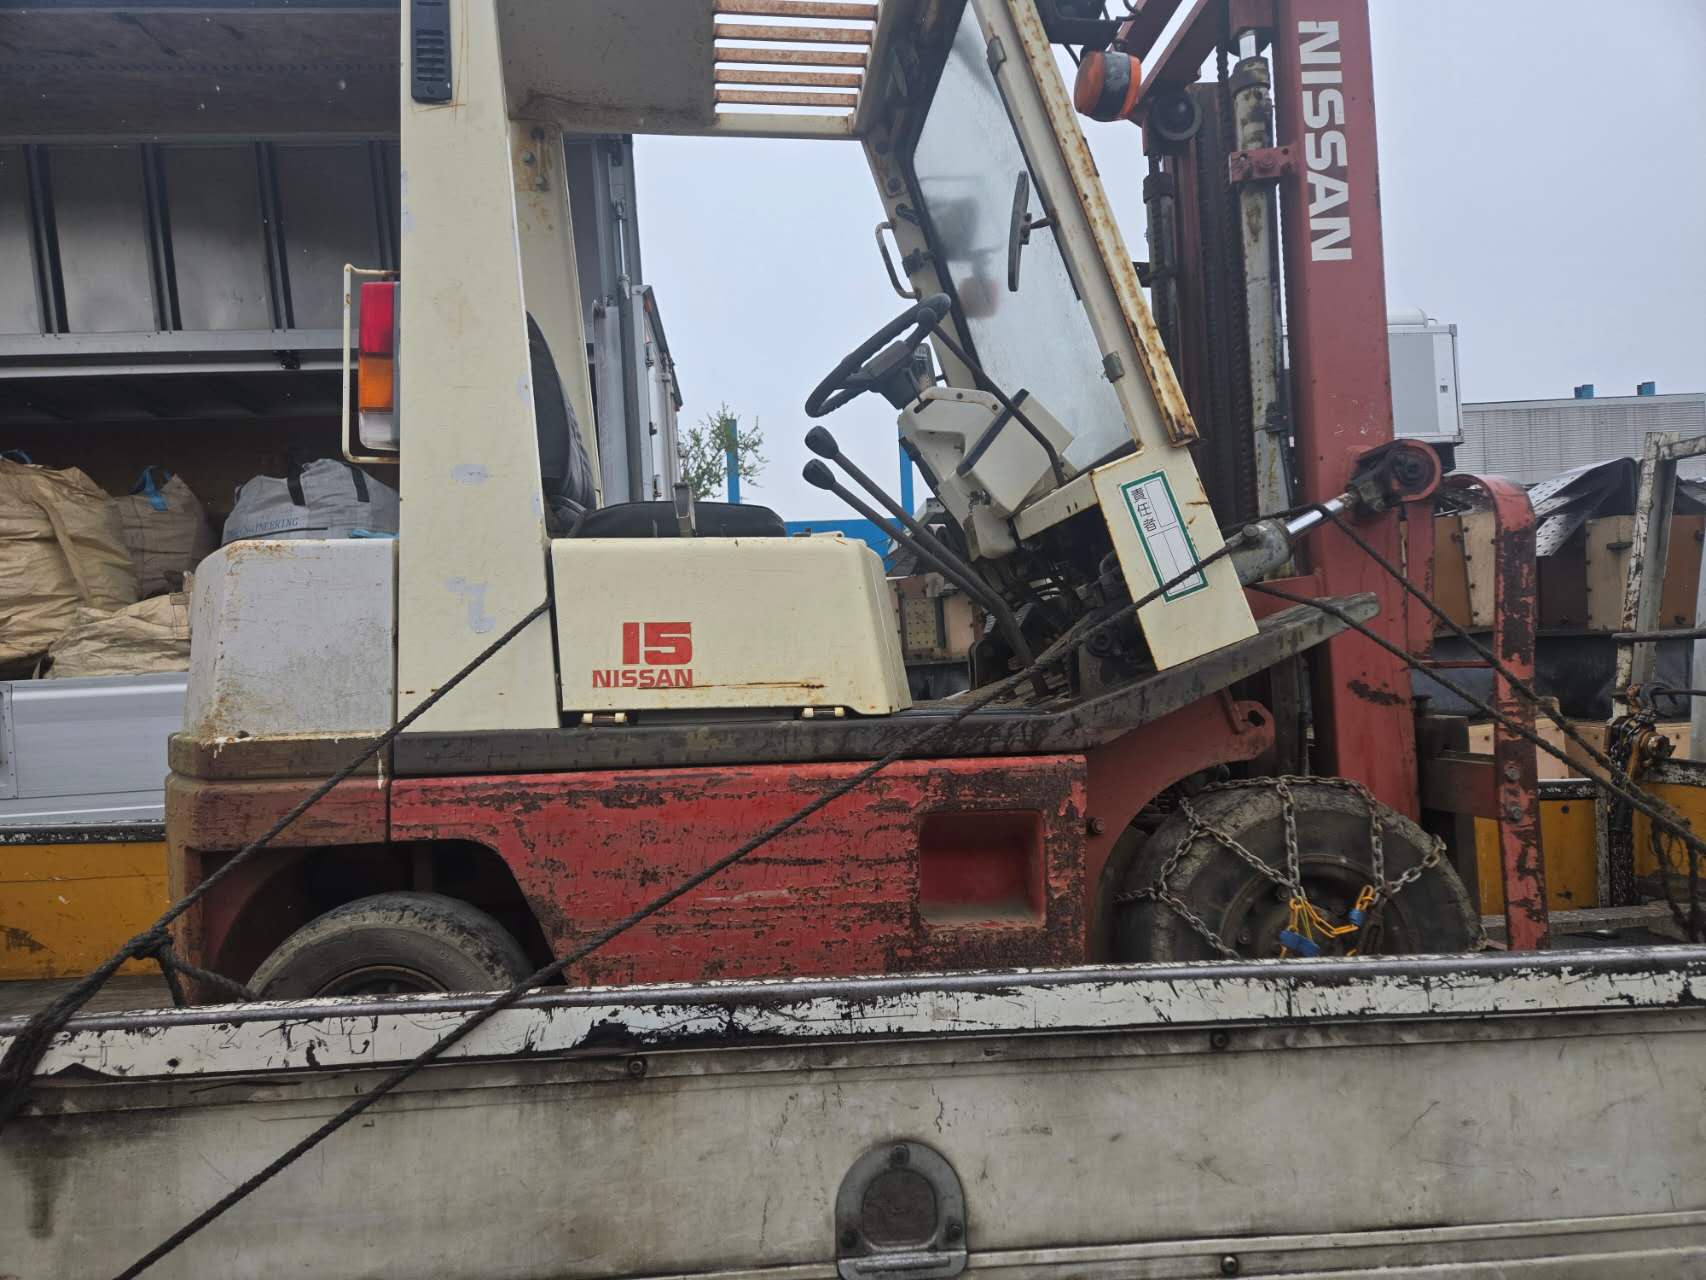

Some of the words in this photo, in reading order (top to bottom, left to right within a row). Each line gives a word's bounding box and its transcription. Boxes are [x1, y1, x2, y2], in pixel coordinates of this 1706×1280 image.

[1298, 21, 1353, 261] NISSAN
[622, 622, 692, 665] 15
[592, 669, 693, 688] NISSAN
